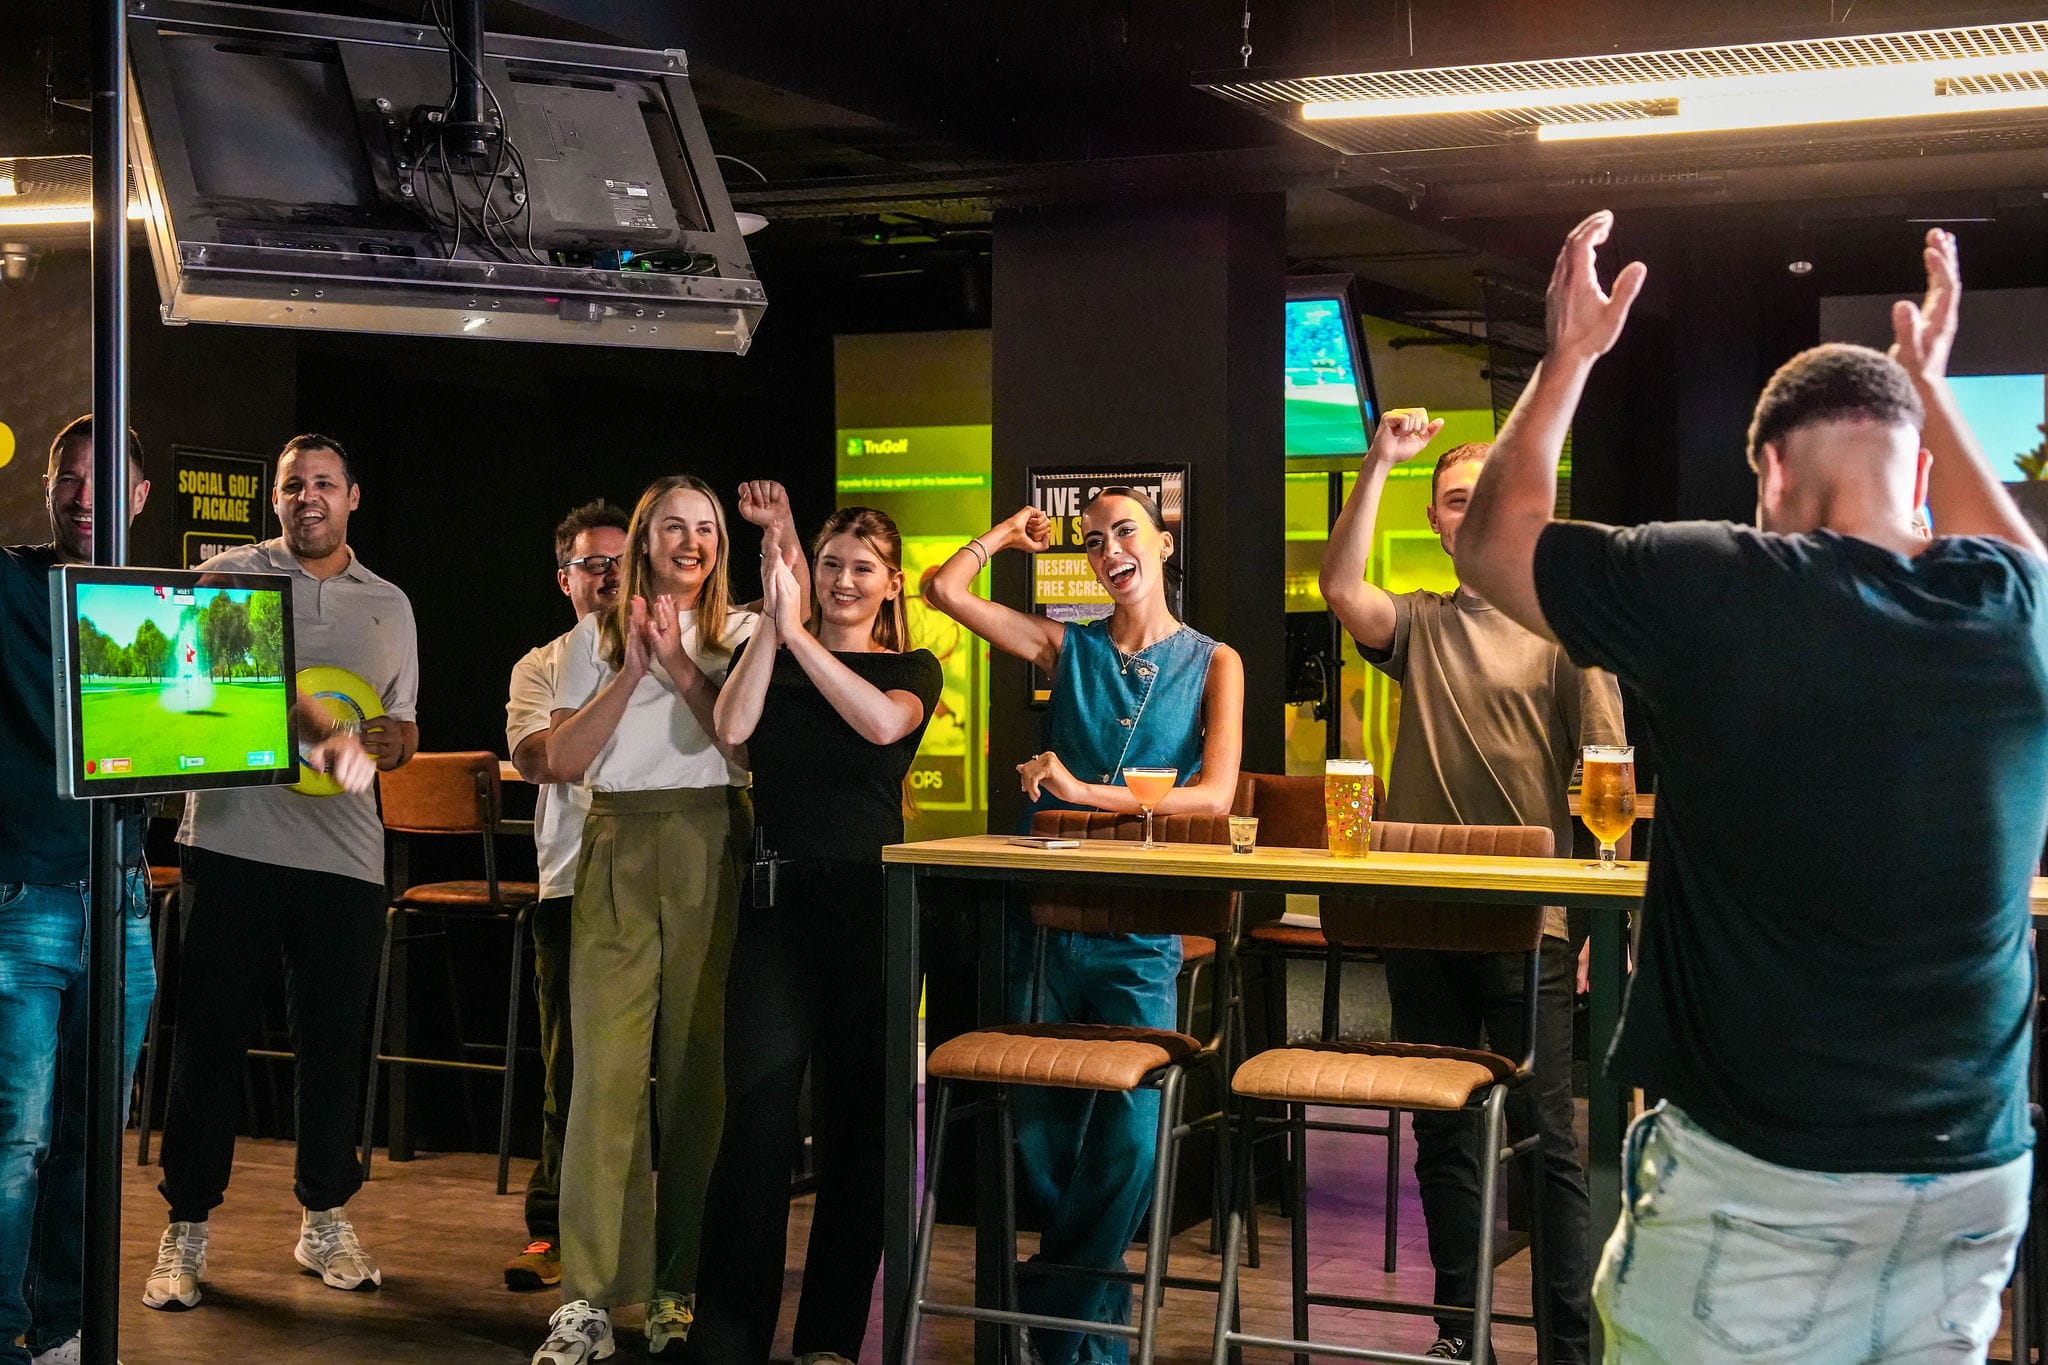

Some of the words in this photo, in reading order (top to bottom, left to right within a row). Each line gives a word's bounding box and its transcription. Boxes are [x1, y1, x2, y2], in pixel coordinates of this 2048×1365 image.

[863, 438, 909, 454] TruGolf
[179, 469, 225, 496] SOCIAL
[228, 474, 259, 499] GOLF
[192, 496, 250, 523] PACKAGE
[1036, 487, 1080, 516] LIVE
[1049, 516, 1064, 546] N
[1036, 559, 1087, 576] RESERVE
[1036, 580, 1065, 597] FREE
[1068, 580, 1109, 597] SCREE
[909, 770, 943, 789] OPS
